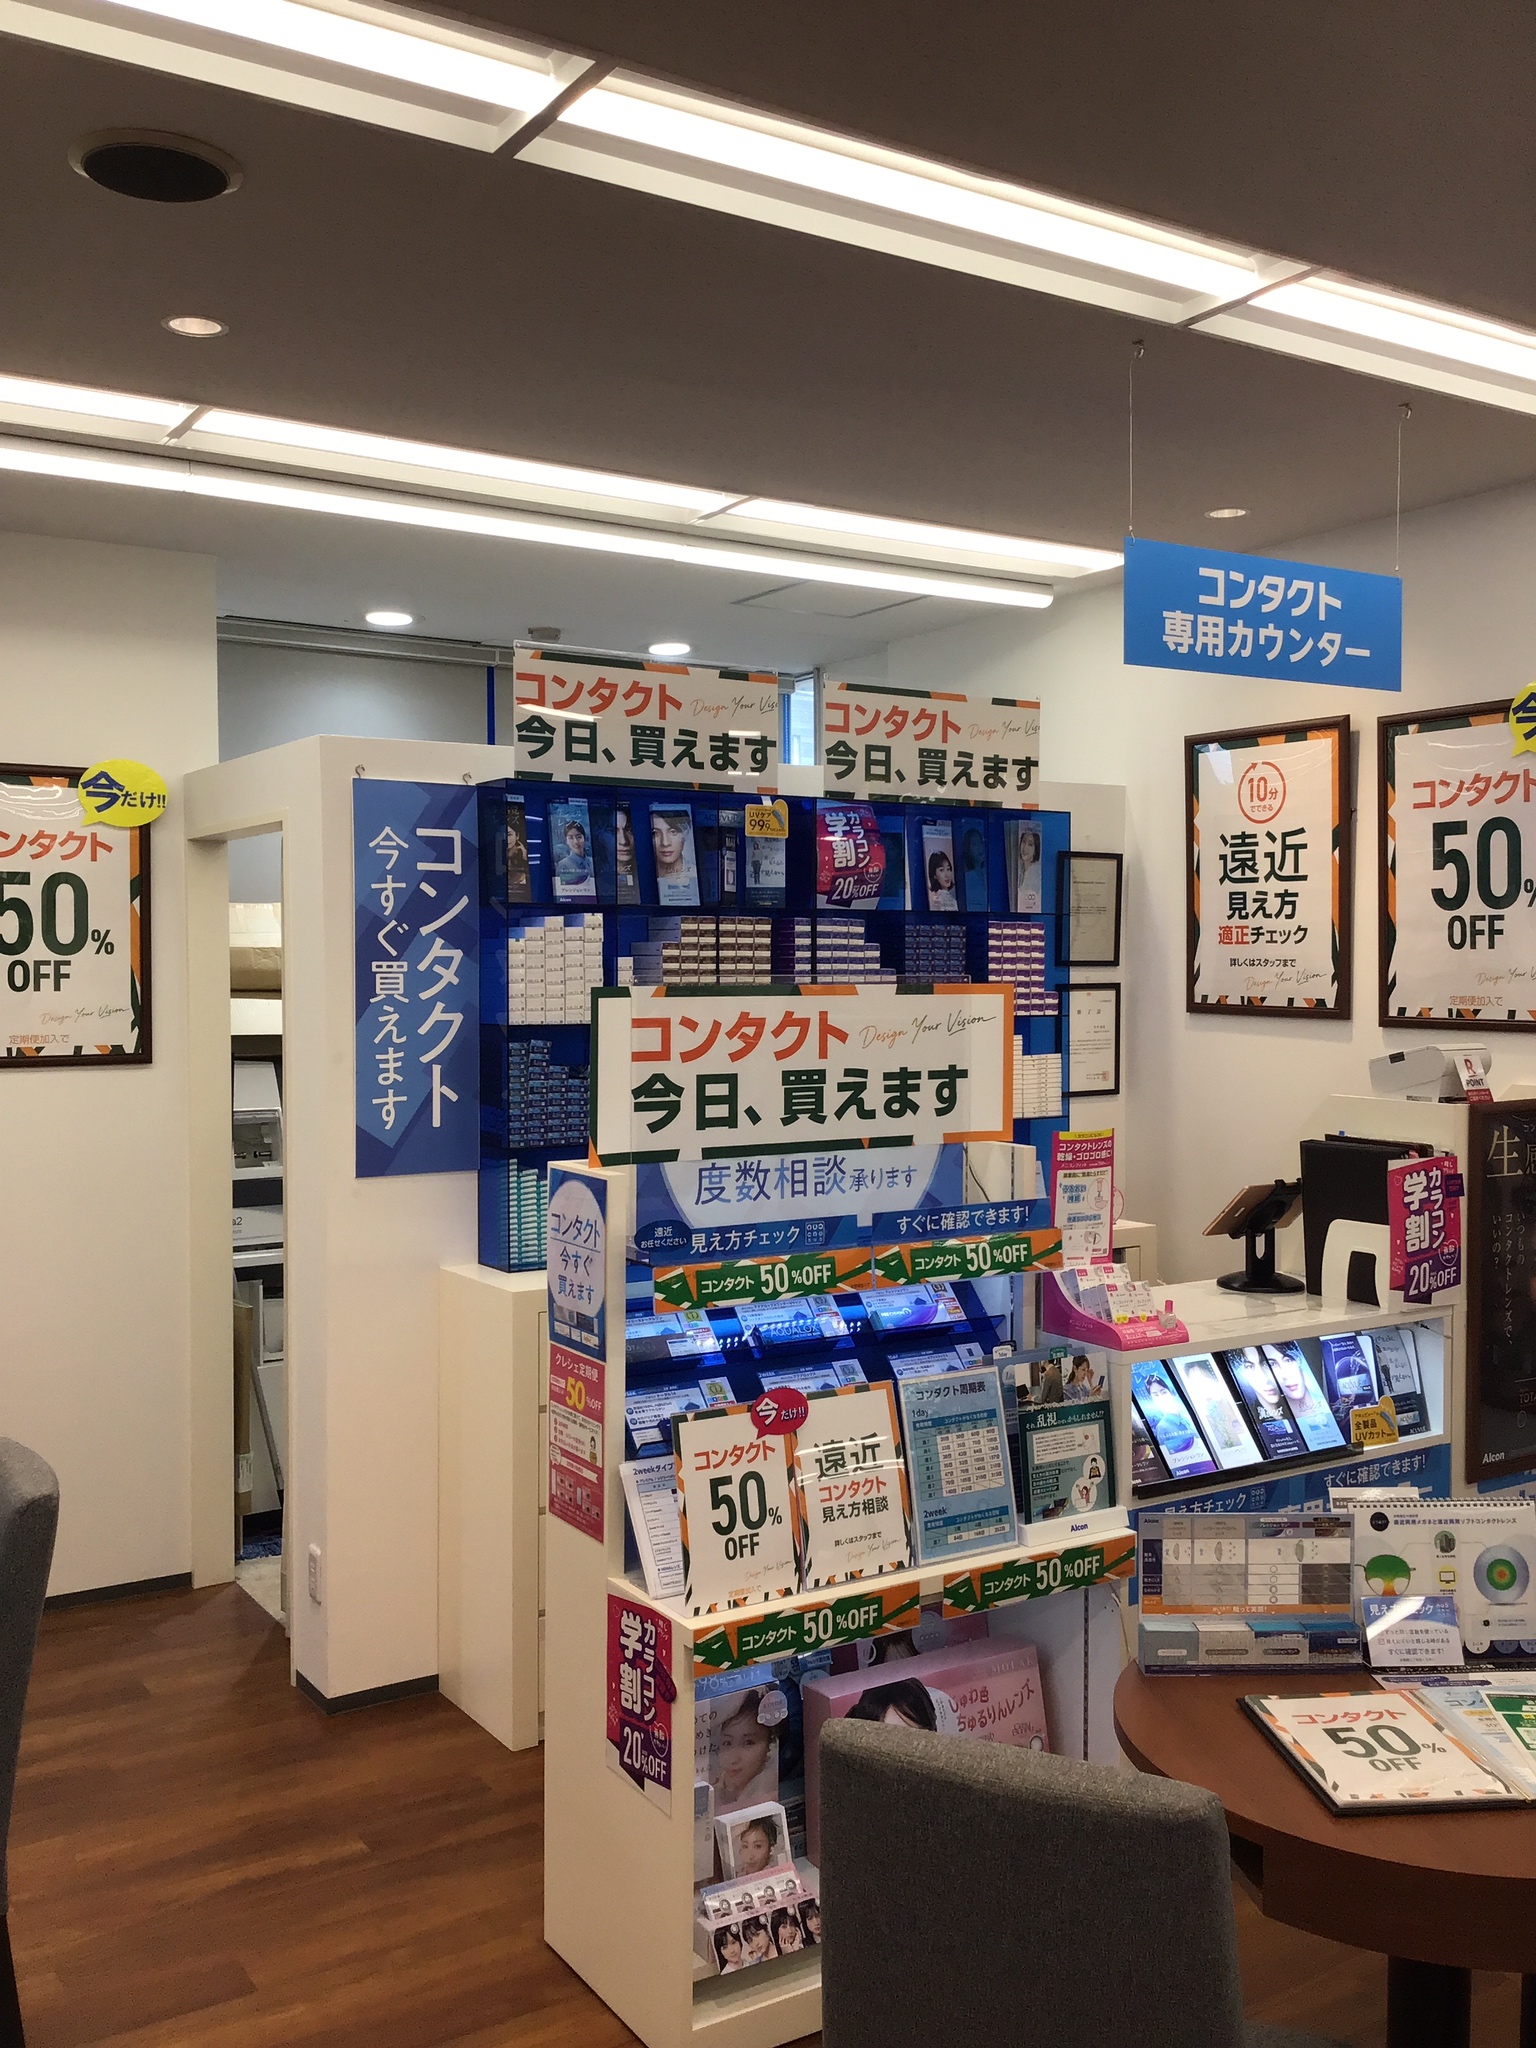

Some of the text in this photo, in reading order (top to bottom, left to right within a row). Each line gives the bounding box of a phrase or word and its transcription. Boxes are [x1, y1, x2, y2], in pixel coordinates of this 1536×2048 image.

[1199, 567, 1341, 621] コンタクト
[1163, 610, 1370, 668] 専用カウンター
[515, 672, 683, 720] コンタクト
[690, 698, 729, 718] Design
[731, 696, 756, 716] Your
[825, 702, 962, 743] コンタクト
[969, 723, 999, 740] Design
[1001, 720, 1021, 739] Your
[515, 715, 777, 772] 今日、買えます
[825, 740, 1039, 791] 今日、買えます
[81, 771, 167, 812] 今だけ!!
[1247, 776, 1279, 804] 10分
[1249, 803, 1274, 813] でできる
[825, 812, 856, 869] 学割
[847, 811, 870, 868] カラコン
[1218, 827, 1308, 886] 遠近
[1226, 888, 1299, 920] 見え方
[1218, 924, 1308, 945] 適正チェック
[1448, 914, 1504, 950] OFF
[7, 959, 71, 992] OFF
[1229, 957, 1297, 968] 詳しくはスタッフまで
[1476, 967, 1527, 986] Design Your
[368, 825, 410, 1131] 今すぐ買えます
[415, 826, 470, 1129] コンタクト
[1244, 970, 1328, 991] Design Your Vision
[40, 1005, 130, 1025] Design Your Vision
[1449, 996, 1503, 1007] 定期便加入で
[9, 1033, 70, 1045] 定期便加入で
[631, 1010, 850, 1064] コンタクト
[859, 1011, 998, 1050] Design Your Vision
[1466, 1078, 1485, 1088] POINT
[631, 1063, 970, 1134] 今日、買えます
[1059, 1140, 1112, 1151] コンタクトレンズの
[694, 1153, 919, 1206] 度数相談承ります
[897, 1206, 1029, 1235] すぐに確認できます!
[1403, 1169, 1430, 1255] 学割
[1428, 1166, 1446, 1249] カラコン
[550, 1212, 600, 1248] コンタクト
[640, 1237, 687, 1249] お任せください
[654, 1226, 673, 1238] 遠近
[690, 1226, 801, 1255] 見え方チェック
[559, 1246, 593, 1277] 今すぐ
[915, 1253, 962, 1271] コンタクト
[557, 1275, 595, 1305] 買えます
[701, 1275, 755, 1294] コンタクト
[555, 1352, 599, 1383] クレシェ定期便
[915, 1380, 986, 1401] コンタクト周期表
[756, 1397, 805, 1426] 今だけ!!
[912, 1408, 929, 1418] 1day
[1354, 1420, 1377, 1430] 全製品
[1355, 1429, 1388, 1441] UVカット
[694, 1440, 776, 1472] コンタクト
[814, 1432, 884, 1483] 遠近
[1482, 1452, 1505, 1464] Alcon
[1324, 1454, 1427, 1488] すぐに確認できます!
[709, 1470, 783, 1537] 50%
[818, 1475, 887, 1504] コンタクト
[821, 1495, 889, 1524] 見え方相談
[923, 1507, 948, 1518] 2week
[834, 1531, 882, 1548] 詳しくはスタッフまで
[1070, 1523, 1088, 1532] Alcon
[724, 1532, 760, 1561] OFF
[984, 1573, 1031, 1596] コンタクト
[742, 1625, 797, 1651] コンタクト
[619, 1609, 643, 1715] 学割
[643, 1618, 657, 1722] カラコン
[956, 1678, 1035, 1732] ちゅるりんレンズ
[1291, 1708, 1406, 1725] コンタクト
[1322, 1724, 1447, 1759] 50%
[1368, 1756, 1422, 1773] OFF
